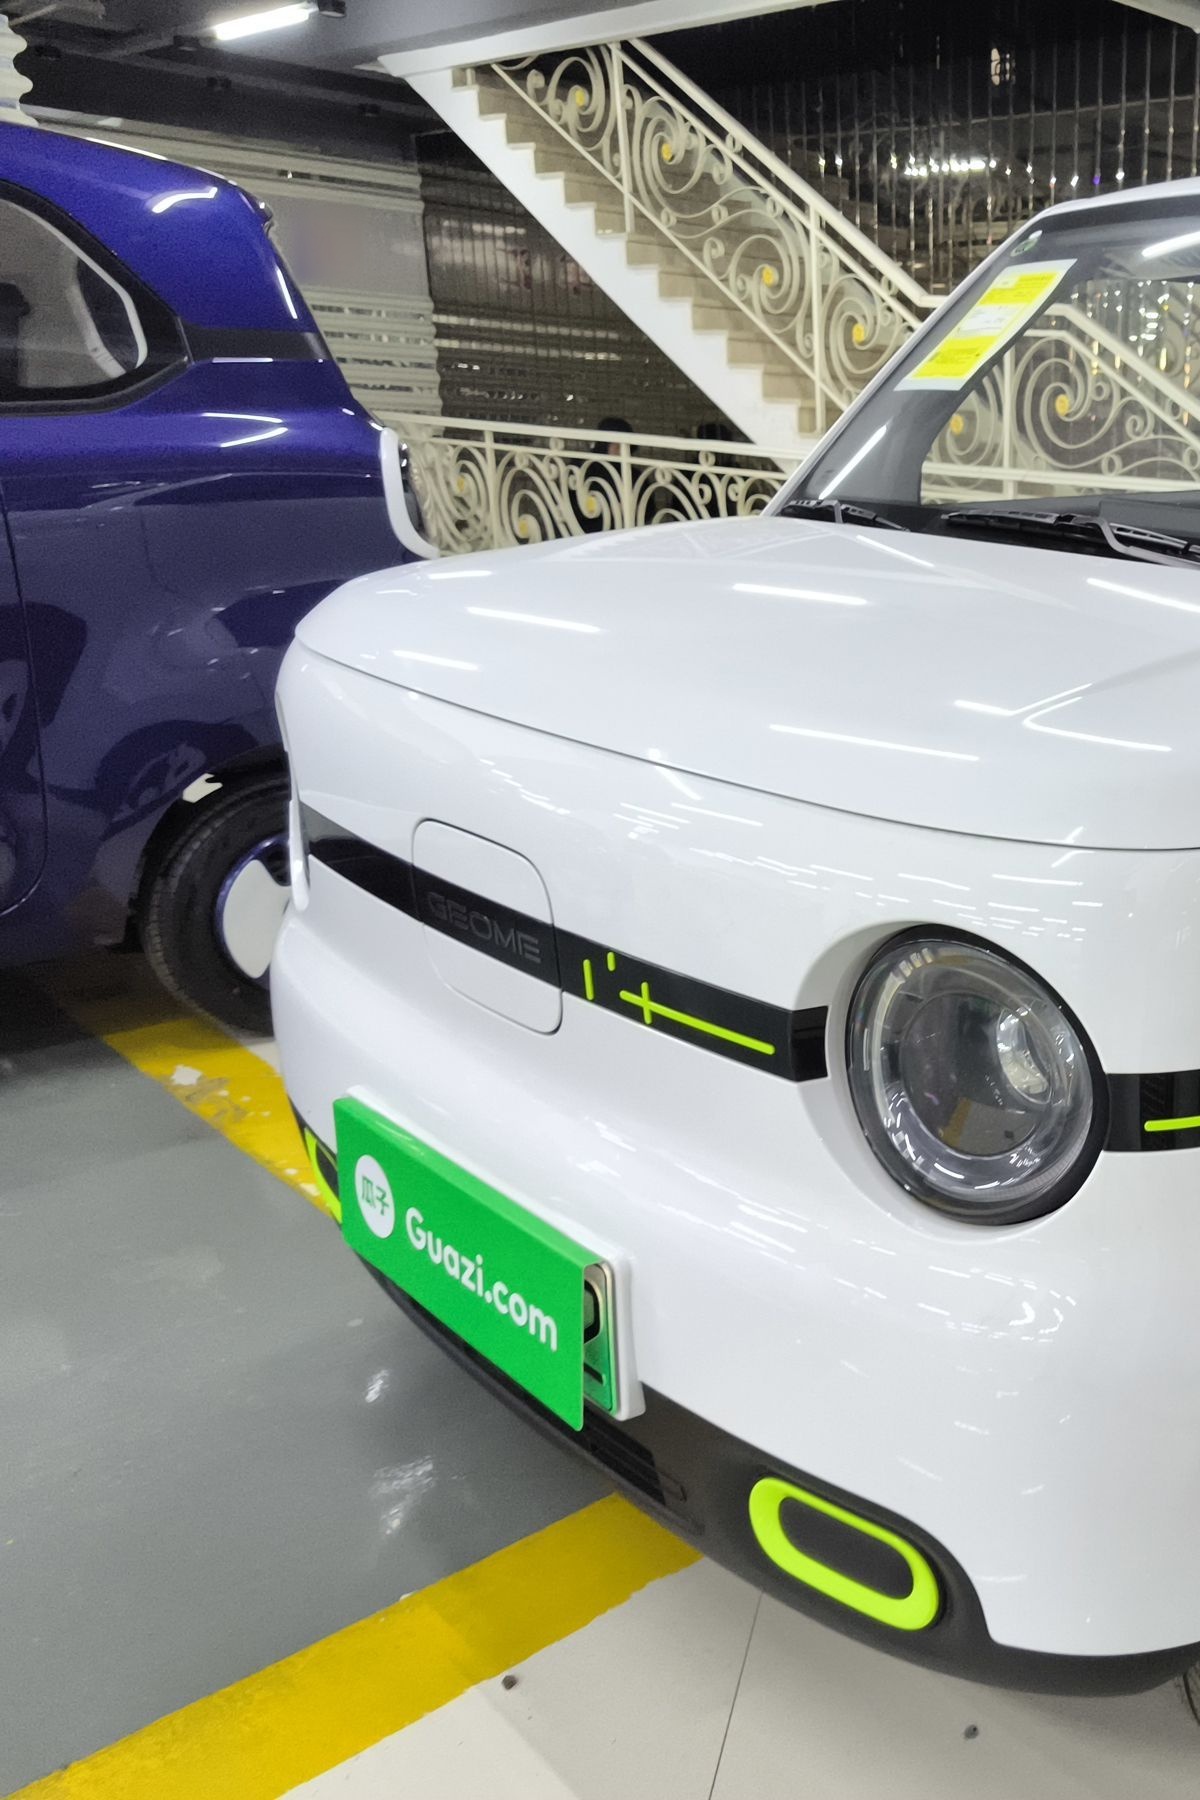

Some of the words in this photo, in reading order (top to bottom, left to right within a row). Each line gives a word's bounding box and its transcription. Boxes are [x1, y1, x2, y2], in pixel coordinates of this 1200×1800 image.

[426, 890, 542, 964] GEOME
[361, 1174, 390, 1216] 瓜子
[405, 1207, 558, 1352] Guazi.com
